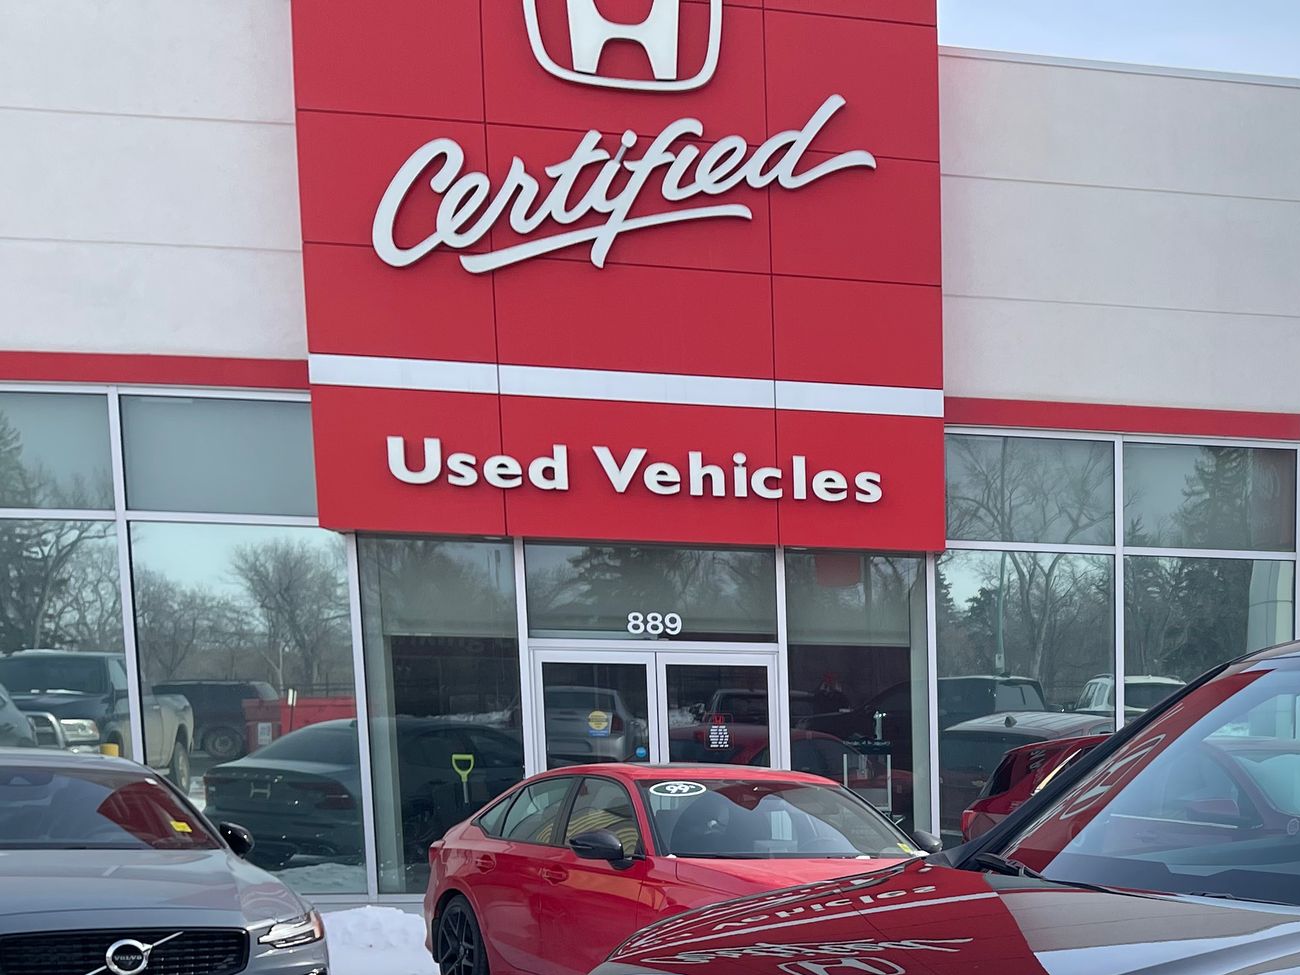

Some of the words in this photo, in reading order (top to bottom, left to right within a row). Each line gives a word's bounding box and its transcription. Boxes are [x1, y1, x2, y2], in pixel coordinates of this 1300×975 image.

[371, 94, 877, 274] Certified
[386, 436, 569, 492] Used
[592, 446, 883, 504] Vehicles
[627, 611, 682, 636] 889
